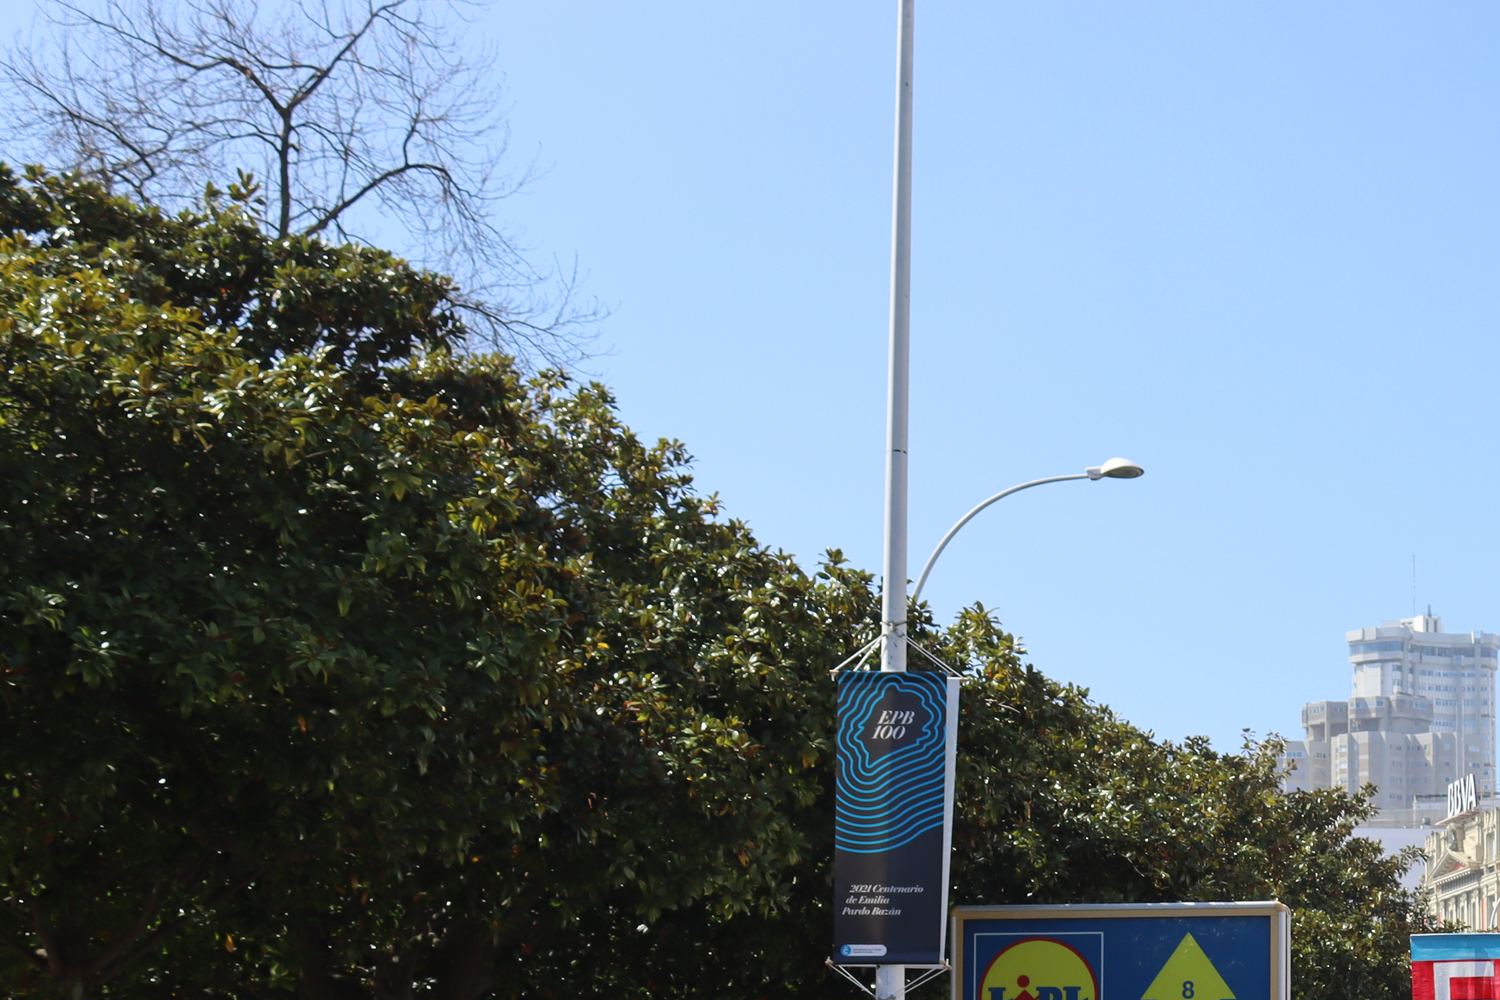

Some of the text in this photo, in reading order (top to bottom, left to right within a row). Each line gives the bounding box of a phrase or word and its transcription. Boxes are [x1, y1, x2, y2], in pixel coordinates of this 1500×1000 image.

[877, 710, 915, 725] EPB
[872, 725, 907, 740] 100
[1447, 773, 1477, 819] BBVA
[849, 884, 925, 893] 2021 Centenario
[845, 895, 890, 904] de Emilia
[841, 906, 871, 916] Pardo
[1181, 981, 1196, 1000] 8
